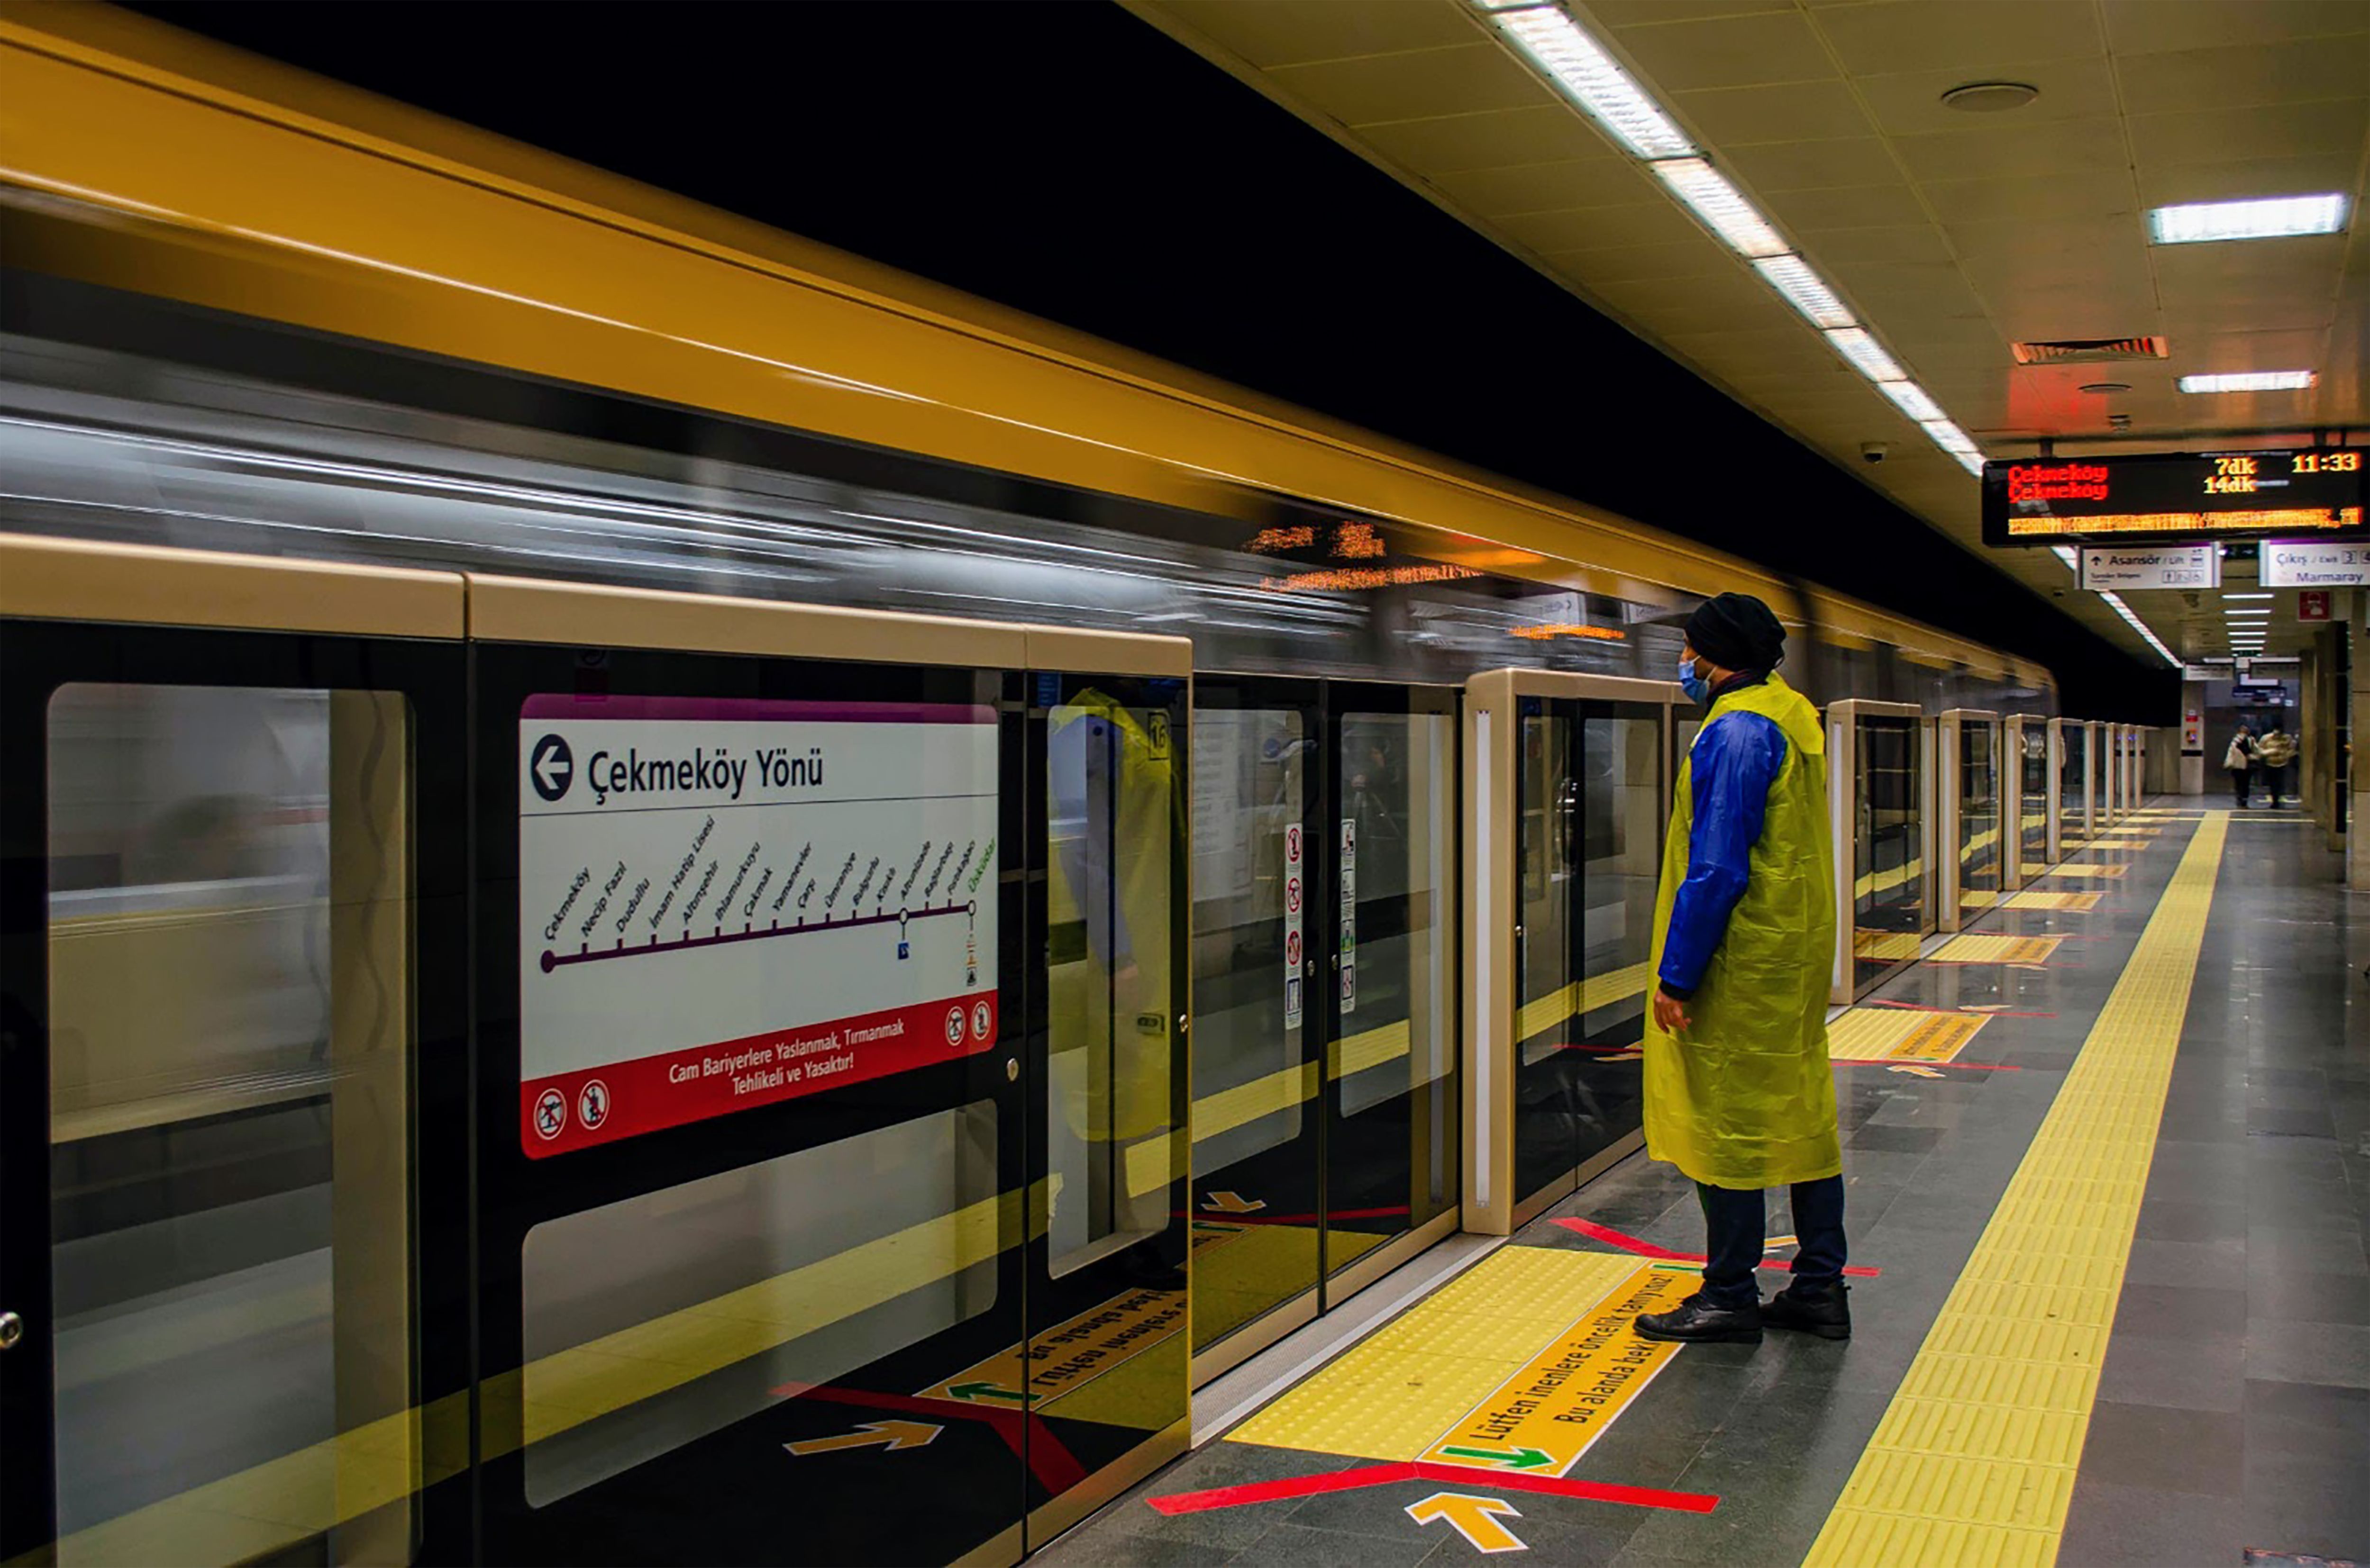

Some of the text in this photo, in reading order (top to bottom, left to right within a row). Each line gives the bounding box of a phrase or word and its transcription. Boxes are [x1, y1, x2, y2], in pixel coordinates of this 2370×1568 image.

[2204, 476, 2258, 494] 14dk
[2215, 457, 2258, 475] 7dk
[2291, 453, 2361, 473] 11:33
[2110, 555, 2160, 565] Asansör
[2277, 553, 2307, 566] Çıkış
[2296, 572, 2363, 584] Marmaray
[588, 747, 823, 805] Çekmeköy Yönü
[672, 853, 695, 890] Hatip
[744, 867, 773, 917] Çakmak
[545, 867, 590, 941] Çekmeköy
[581, 897, 608, 937] Necip
[616, 878, 650, 933] Dudullu
[669, 1018, 904, 1084] Cam Bariyerlere Yaslanmak, Tırmanmak
[732, 1052, 854, 1096] Tehlikeli ve Yasaktır!
[1469, 1400, 1540, 1440] Lütfen
[1514, 1351, 1592, 1397] inenlere
[1553, 1407, 1596, 1423] Bu
[1577, 1366, 1636, 1405] alanda
